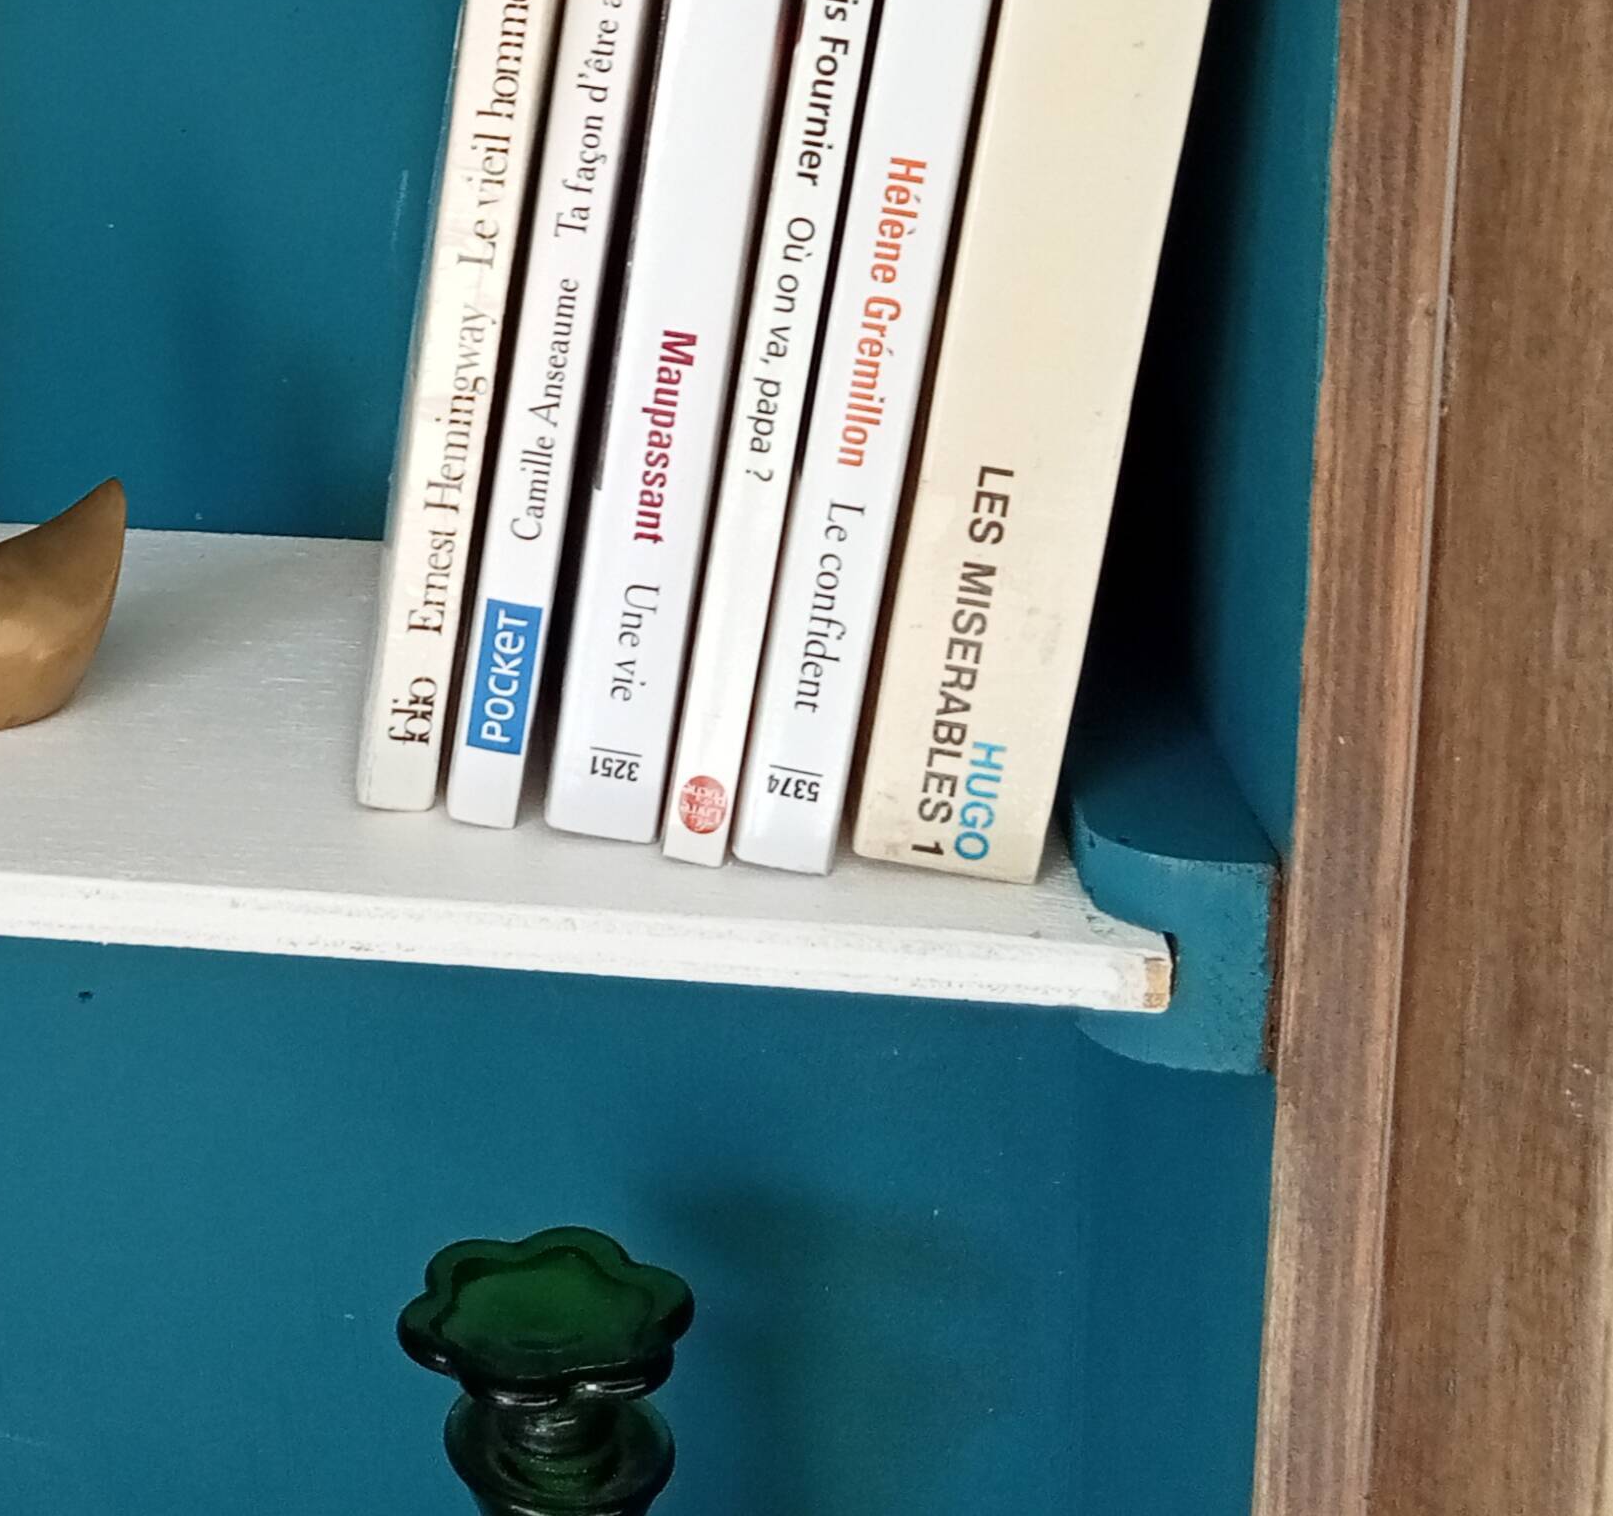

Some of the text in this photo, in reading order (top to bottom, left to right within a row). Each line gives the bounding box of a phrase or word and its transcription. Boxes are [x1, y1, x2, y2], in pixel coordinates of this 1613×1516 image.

[576, 20, 619, 103] d'être
[796, 35, 850, 186] Fournier
[465, 134, 511, 207] vieil
[562, 115, 607, 193] façon
[457, 219, 499, 269] Le
[554, 206, 591, 238] Ta
[783, 217, 816, 262] Où
[773, 274, 799, 314] on
[529, 278, 579, 427] Anseaume
[760, 326, 792, 365] va,
[424, 303, 497, 514] Hemingway
[746, 377, 781, 454] papa
[794, 156, 927, 713] Hélène Grémillon Le confident
[510, 436, 555, 541] Camille
[611, 330, 698, 702] Maupassant Une vie
[406, 527, 459, 635] Ernest
[911, 465, 1015, 857] LES MISERABLES 1
[590, 755, 640, 782] 3251
[766, 774, 820, 803] 5374
[953, 740, 1007, 861] HUGO
